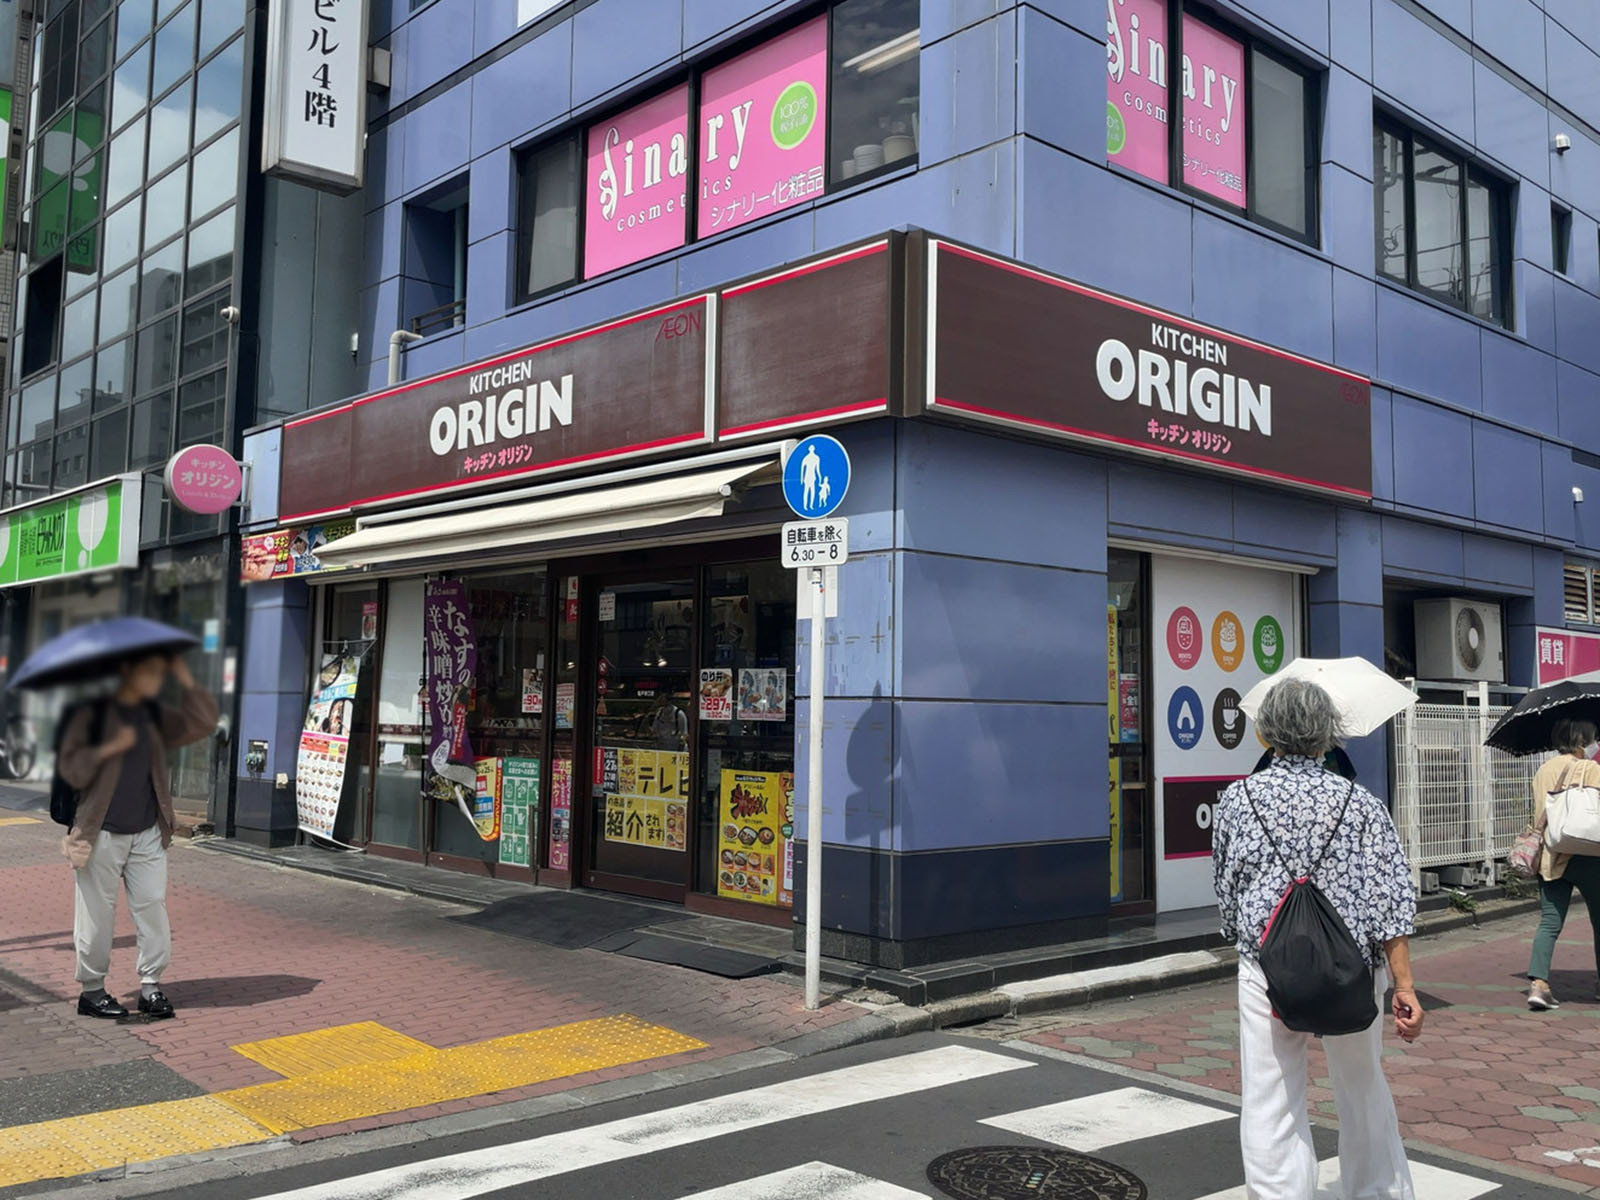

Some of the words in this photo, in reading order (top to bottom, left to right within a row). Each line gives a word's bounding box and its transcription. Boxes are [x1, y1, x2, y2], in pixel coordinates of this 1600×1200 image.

[711, 165, 825, 228] シナリー化粧品
[1151, 323, 1227, 367] KITCHEN
[469, 359, 533, 395] KITCHEN
[1096, 338, 1272, 437] ORIGIN
[429, 374, 574, 456] ORIGIN
[1147, 418, 1190, 445] キッチン
[1191, 429, 1232, 454] オリジン
[190, 457, 227, 470] キッチン
[463, 454, 497, 474] キッチン
[498, 443, 534, 466] オリジン
[180, 471, 236, 489] オリジン
[787, 525, 842, 544] 自転車を除く
[443, 600, 474, 683] なすの
[1541, 638, 1564, 665] 賃貸
[607, 809, 644, 840] 紹介
